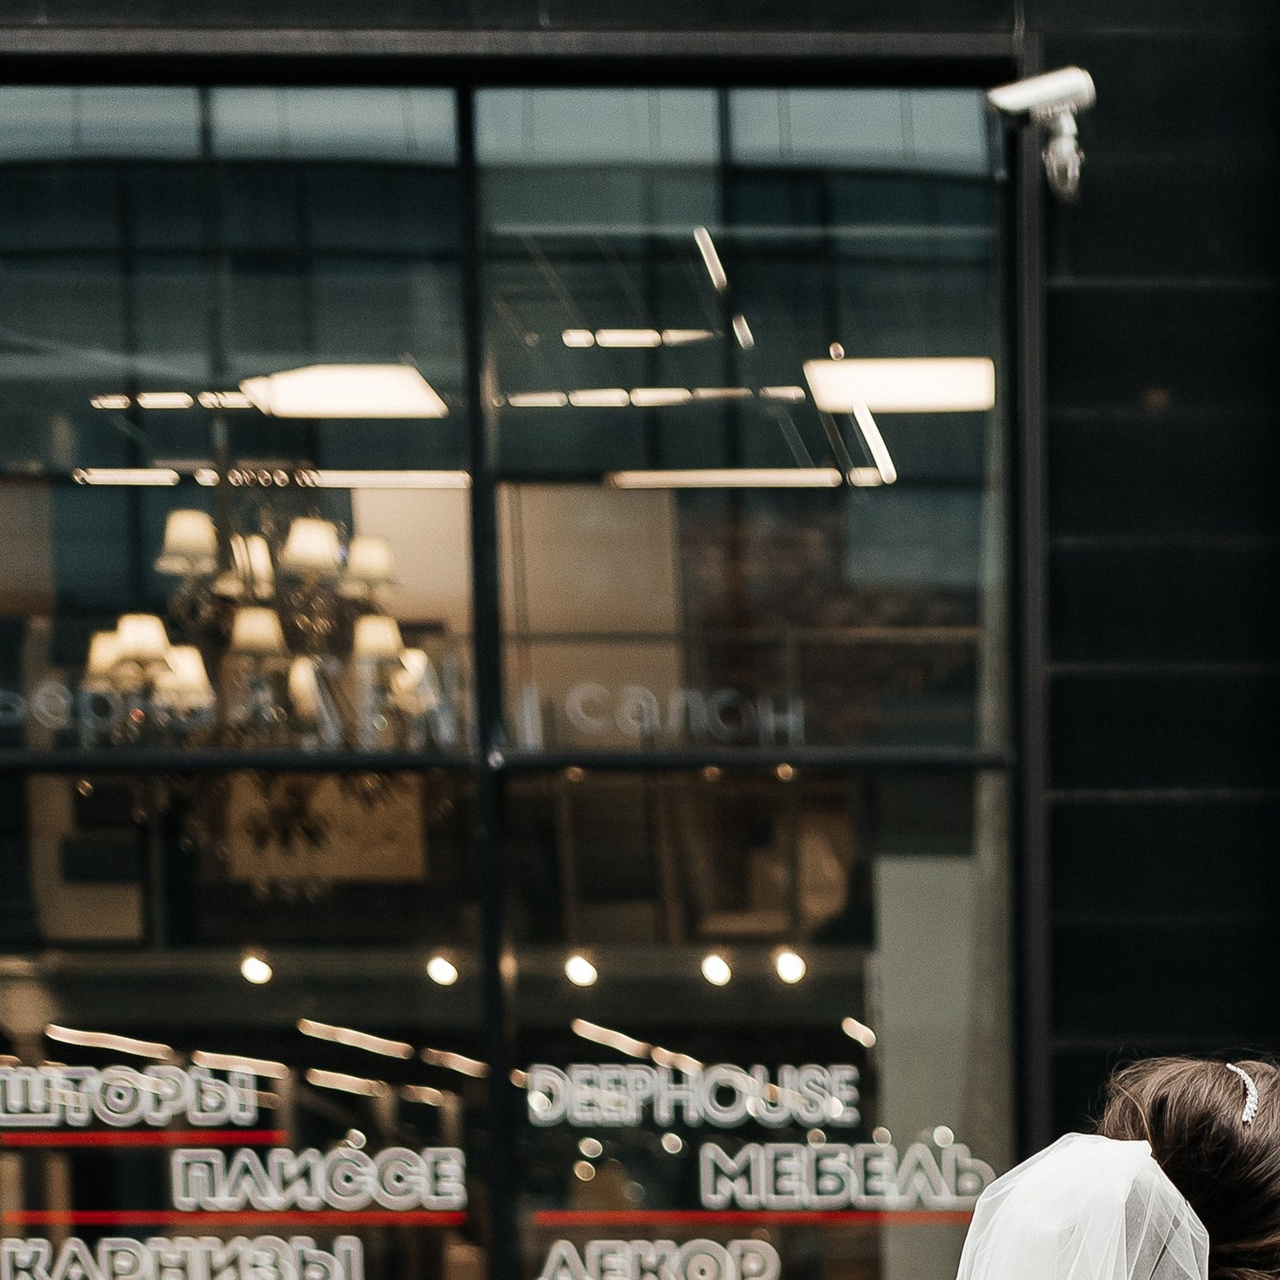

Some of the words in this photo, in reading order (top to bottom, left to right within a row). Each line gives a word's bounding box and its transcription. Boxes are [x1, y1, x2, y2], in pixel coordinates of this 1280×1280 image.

[0, 1065, 259, 1127] ШТОРЫ
[527, 1064, 862, 1128] DEEPHOUSE
[170, 1147, 468, 1211] ПЛИССЕ
[700, 1142, 998, 1210] МЕБЕЛЬ
